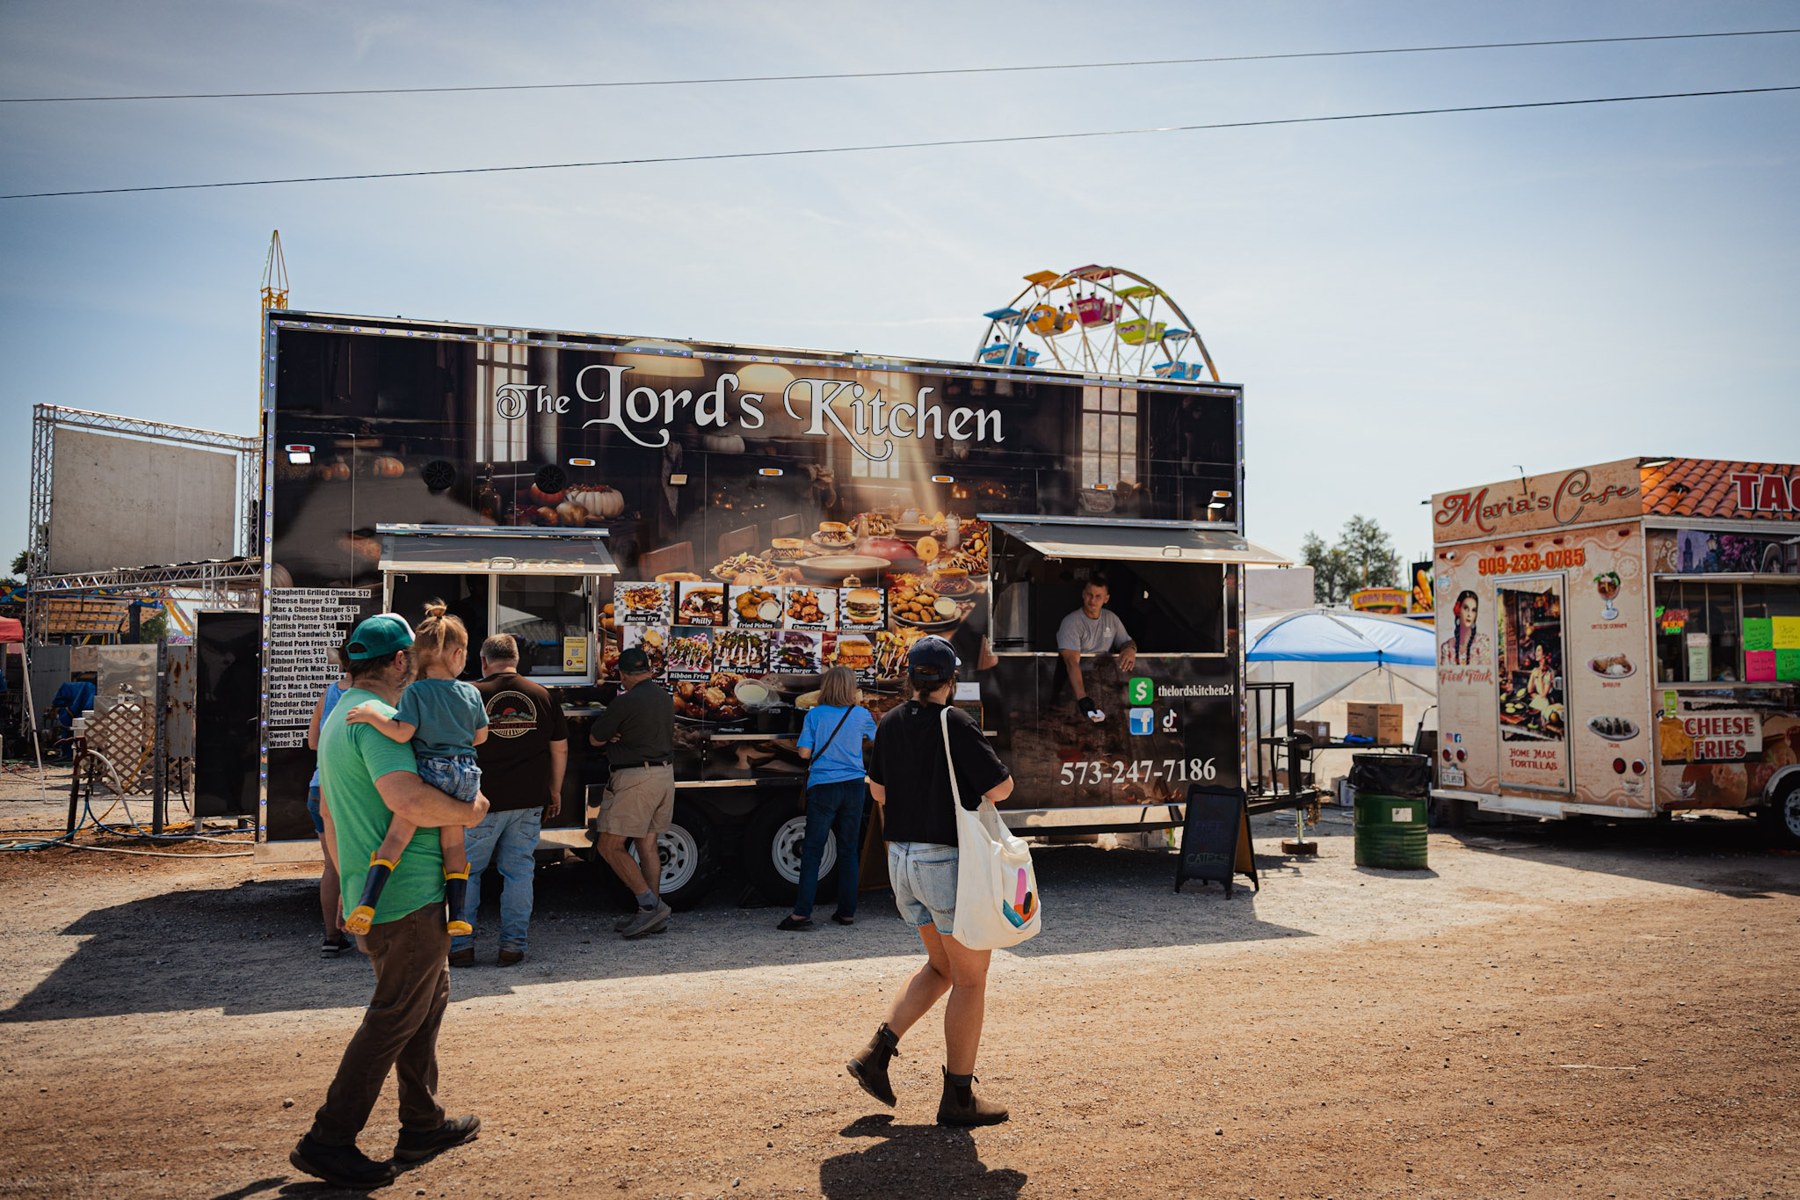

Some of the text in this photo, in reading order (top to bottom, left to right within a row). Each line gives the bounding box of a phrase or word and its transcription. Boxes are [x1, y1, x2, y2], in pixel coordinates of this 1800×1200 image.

[496, 365, 1005, 462] The Lord's Kitchen
[1435, 470, 1638, 532] Maria's Cafe
[1478, 548, 1585, 576] 909-233-0785
[272, 588, 305, 597] Spaghetti
[272, 614, 290, 622] Philly
[321, 606, 344, 614] Burger
[647, 615, 658, 623] Fry
[691, 617, 712, 626] Philly
[1158, 684, 1234, 697] thelordskitchen24
[1684, 716, 1754, 736] CHEESE
[1694, 740, 1746, 759] FRIES
[1060, 758, 1216, 786] 573-247-7186
